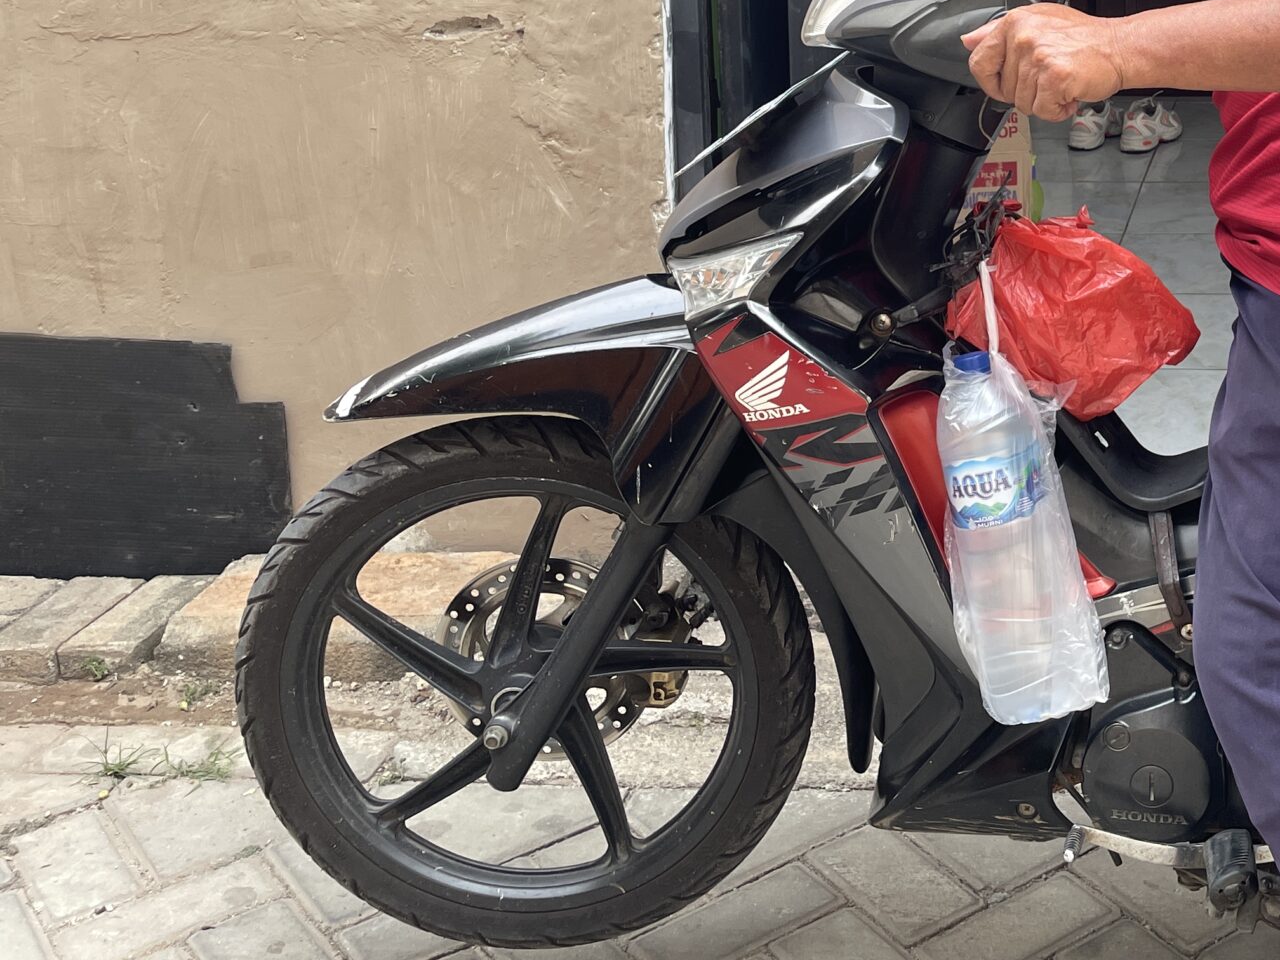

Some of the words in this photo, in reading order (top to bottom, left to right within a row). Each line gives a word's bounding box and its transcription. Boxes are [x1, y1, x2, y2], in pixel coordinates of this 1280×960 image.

[742, 403, 811, 423] HONDA
[952, 467, 1012, 500] AQUA
[1111, 808, 1189, 826] HONDA
